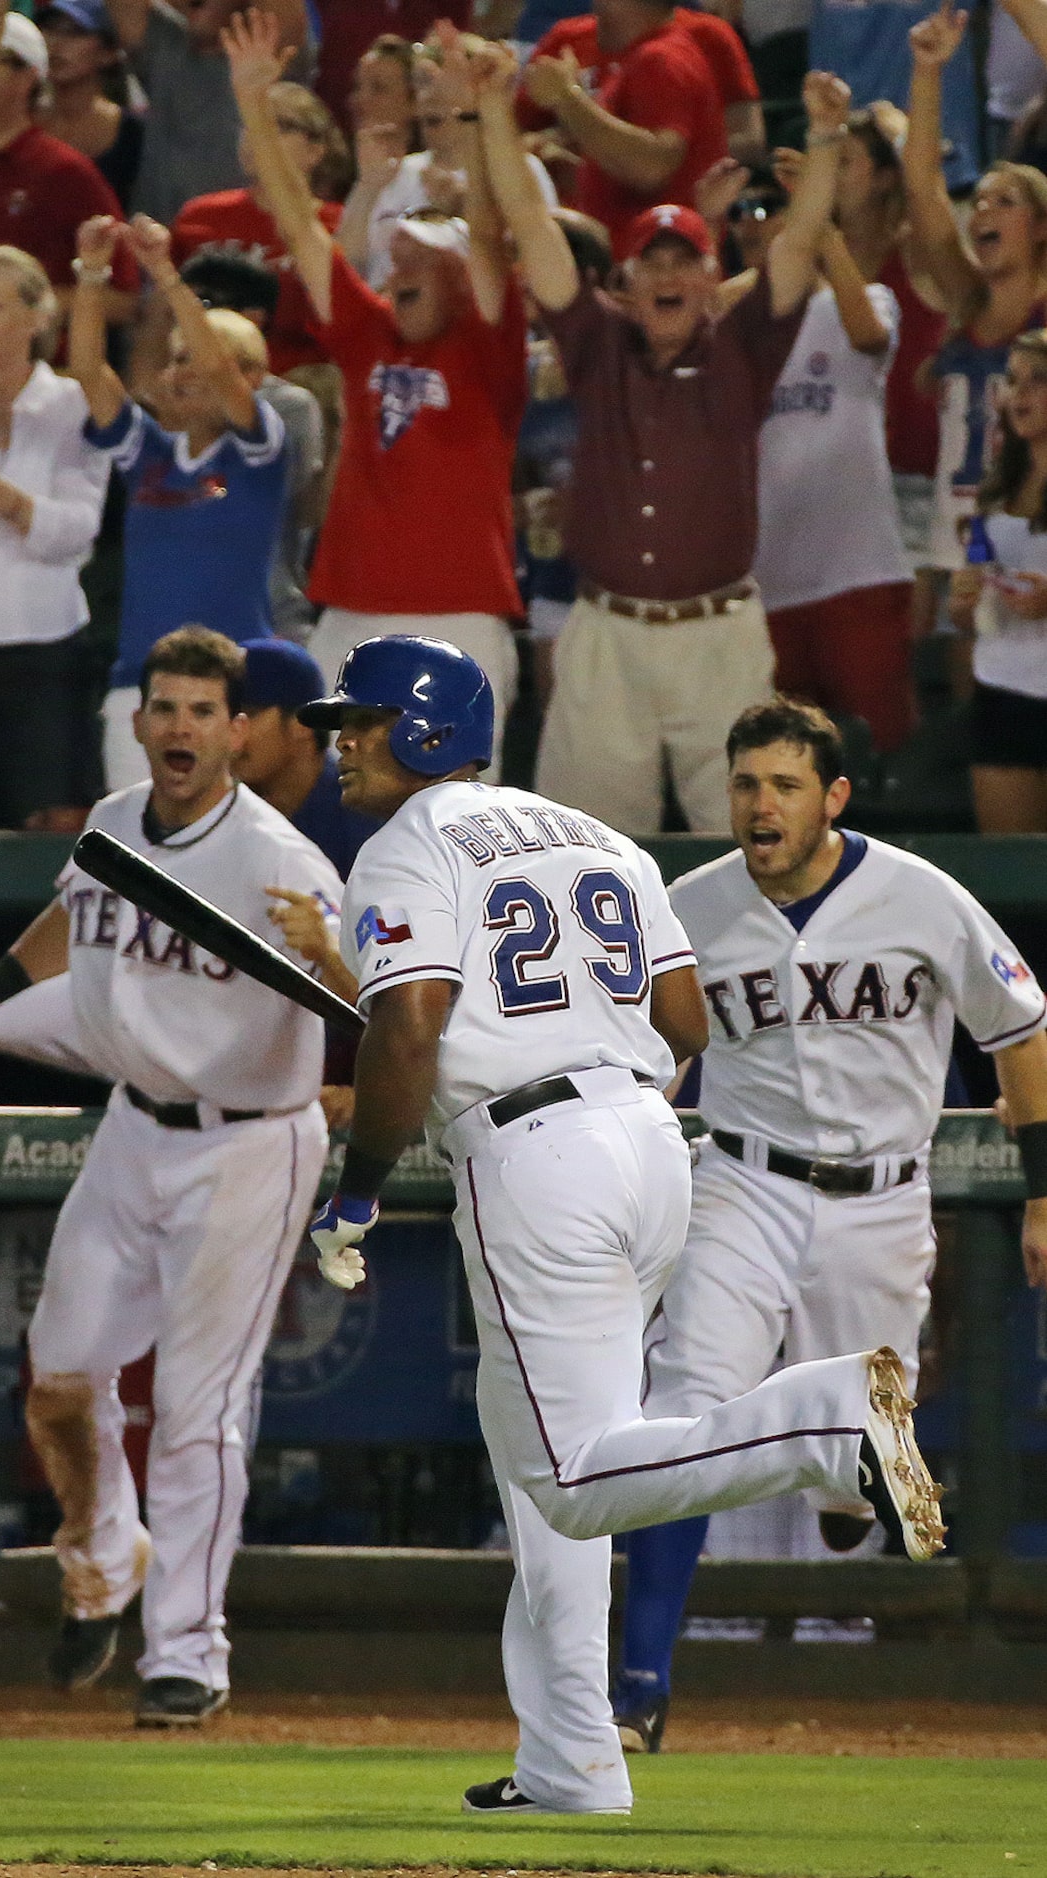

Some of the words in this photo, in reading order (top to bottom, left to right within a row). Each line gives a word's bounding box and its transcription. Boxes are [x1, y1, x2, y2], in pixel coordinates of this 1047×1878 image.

[439, 805, 622, 868] BELTRE
[482, 866, 652, 1018] 29
[704, 960, 934, 1040] TEXAS
